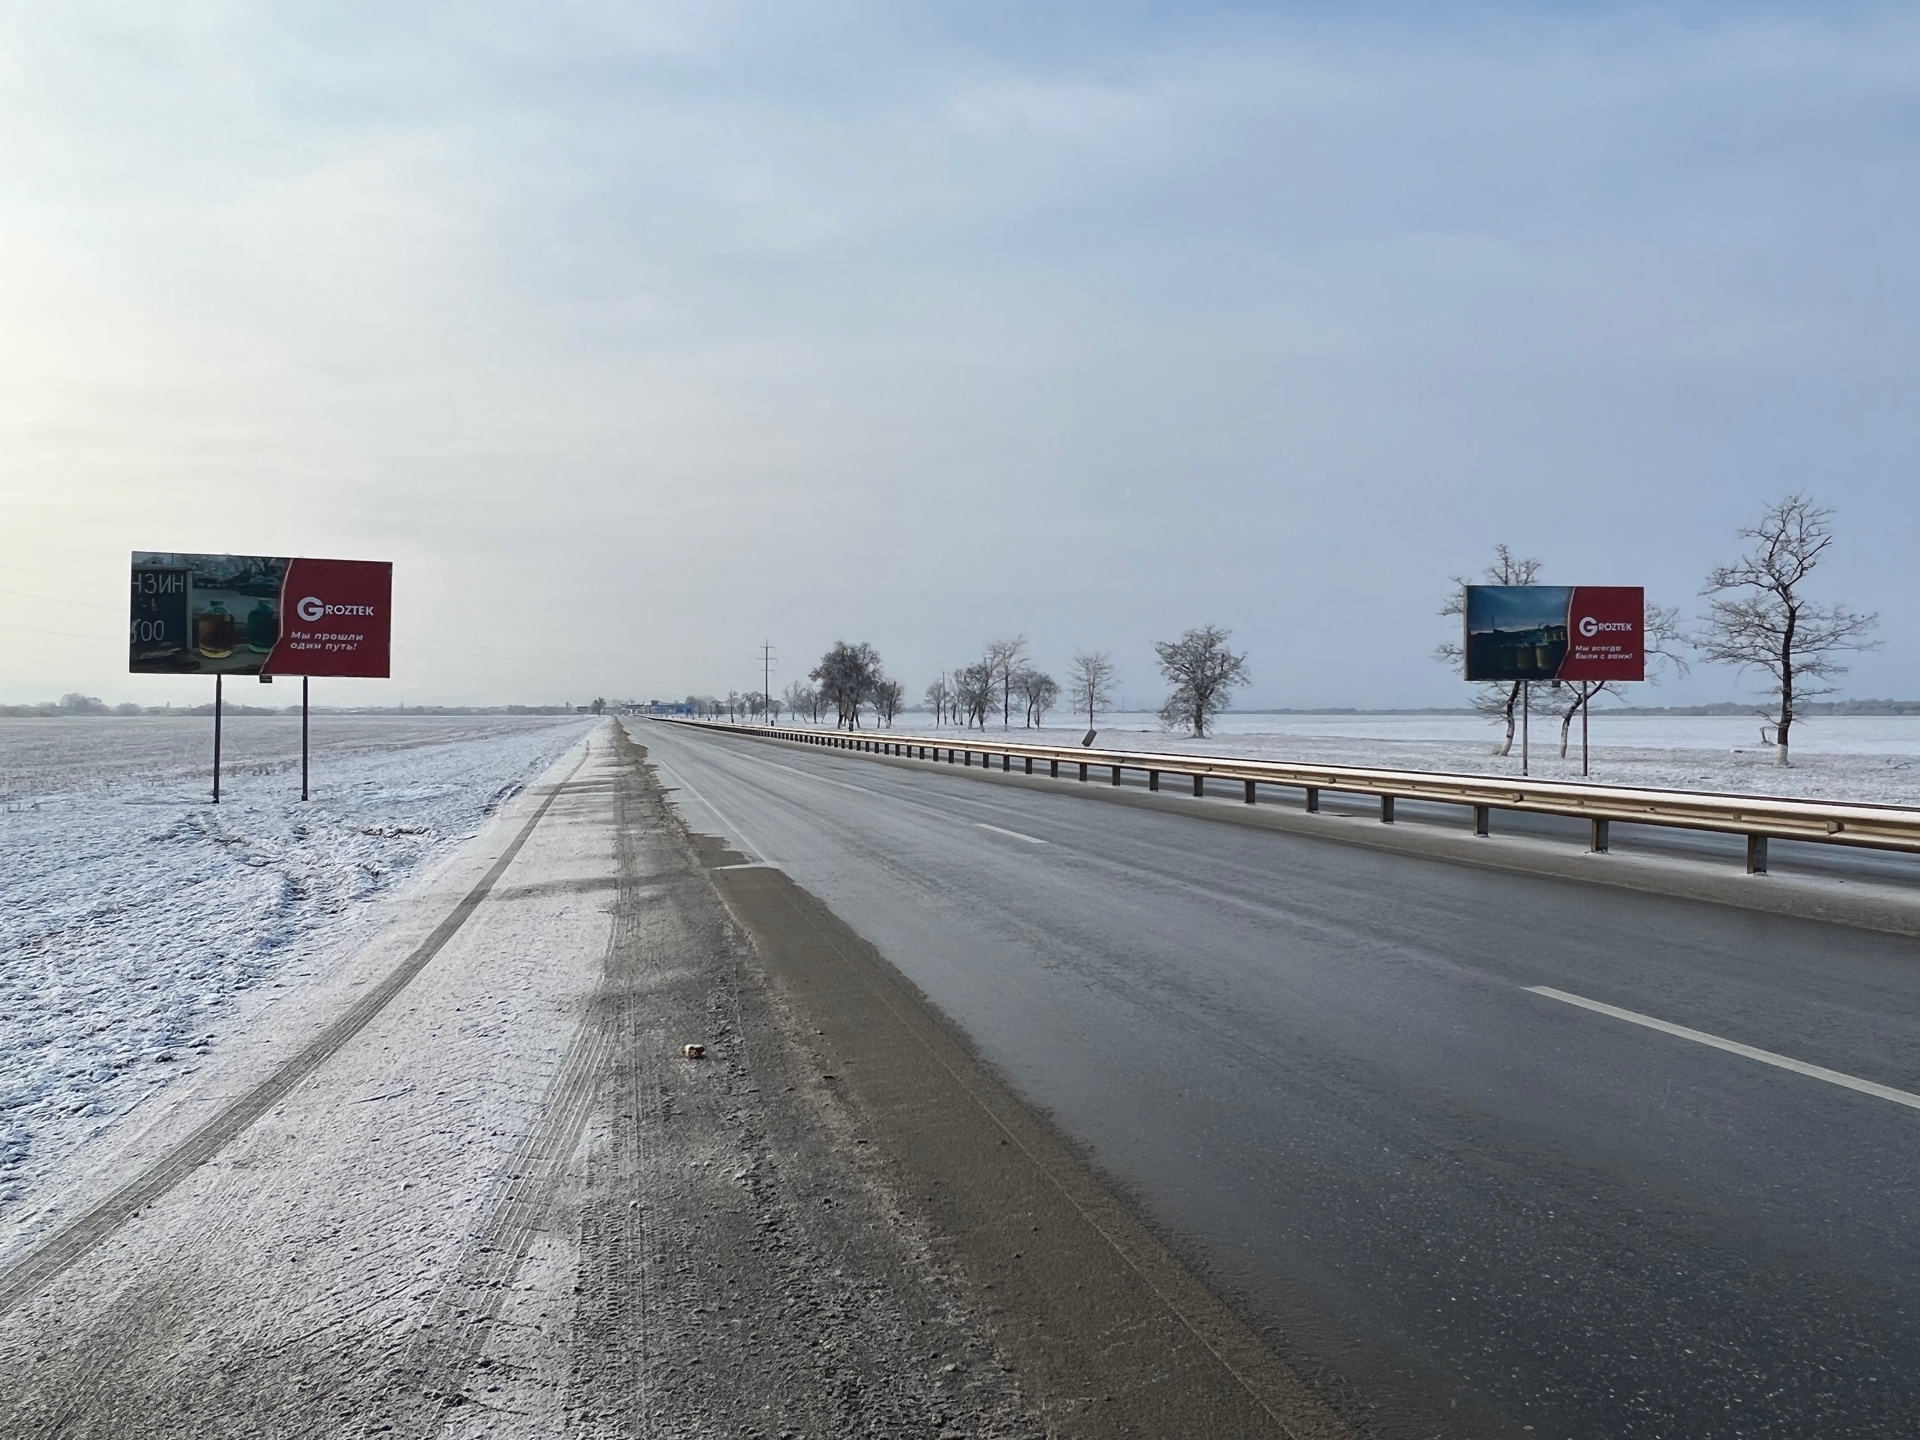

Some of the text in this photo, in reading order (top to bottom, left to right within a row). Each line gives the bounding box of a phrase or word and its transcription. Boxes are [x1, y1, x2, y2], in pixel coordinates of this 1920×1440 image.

[297, 596, 374, 622] GROZTEK
[1579, 616, 1632, 637] GROZTEK
[290, 631, 363, 641] Мы прошли
[290, 642, 357, 652] один путь!
[1575, 652, 1598, 660] были
